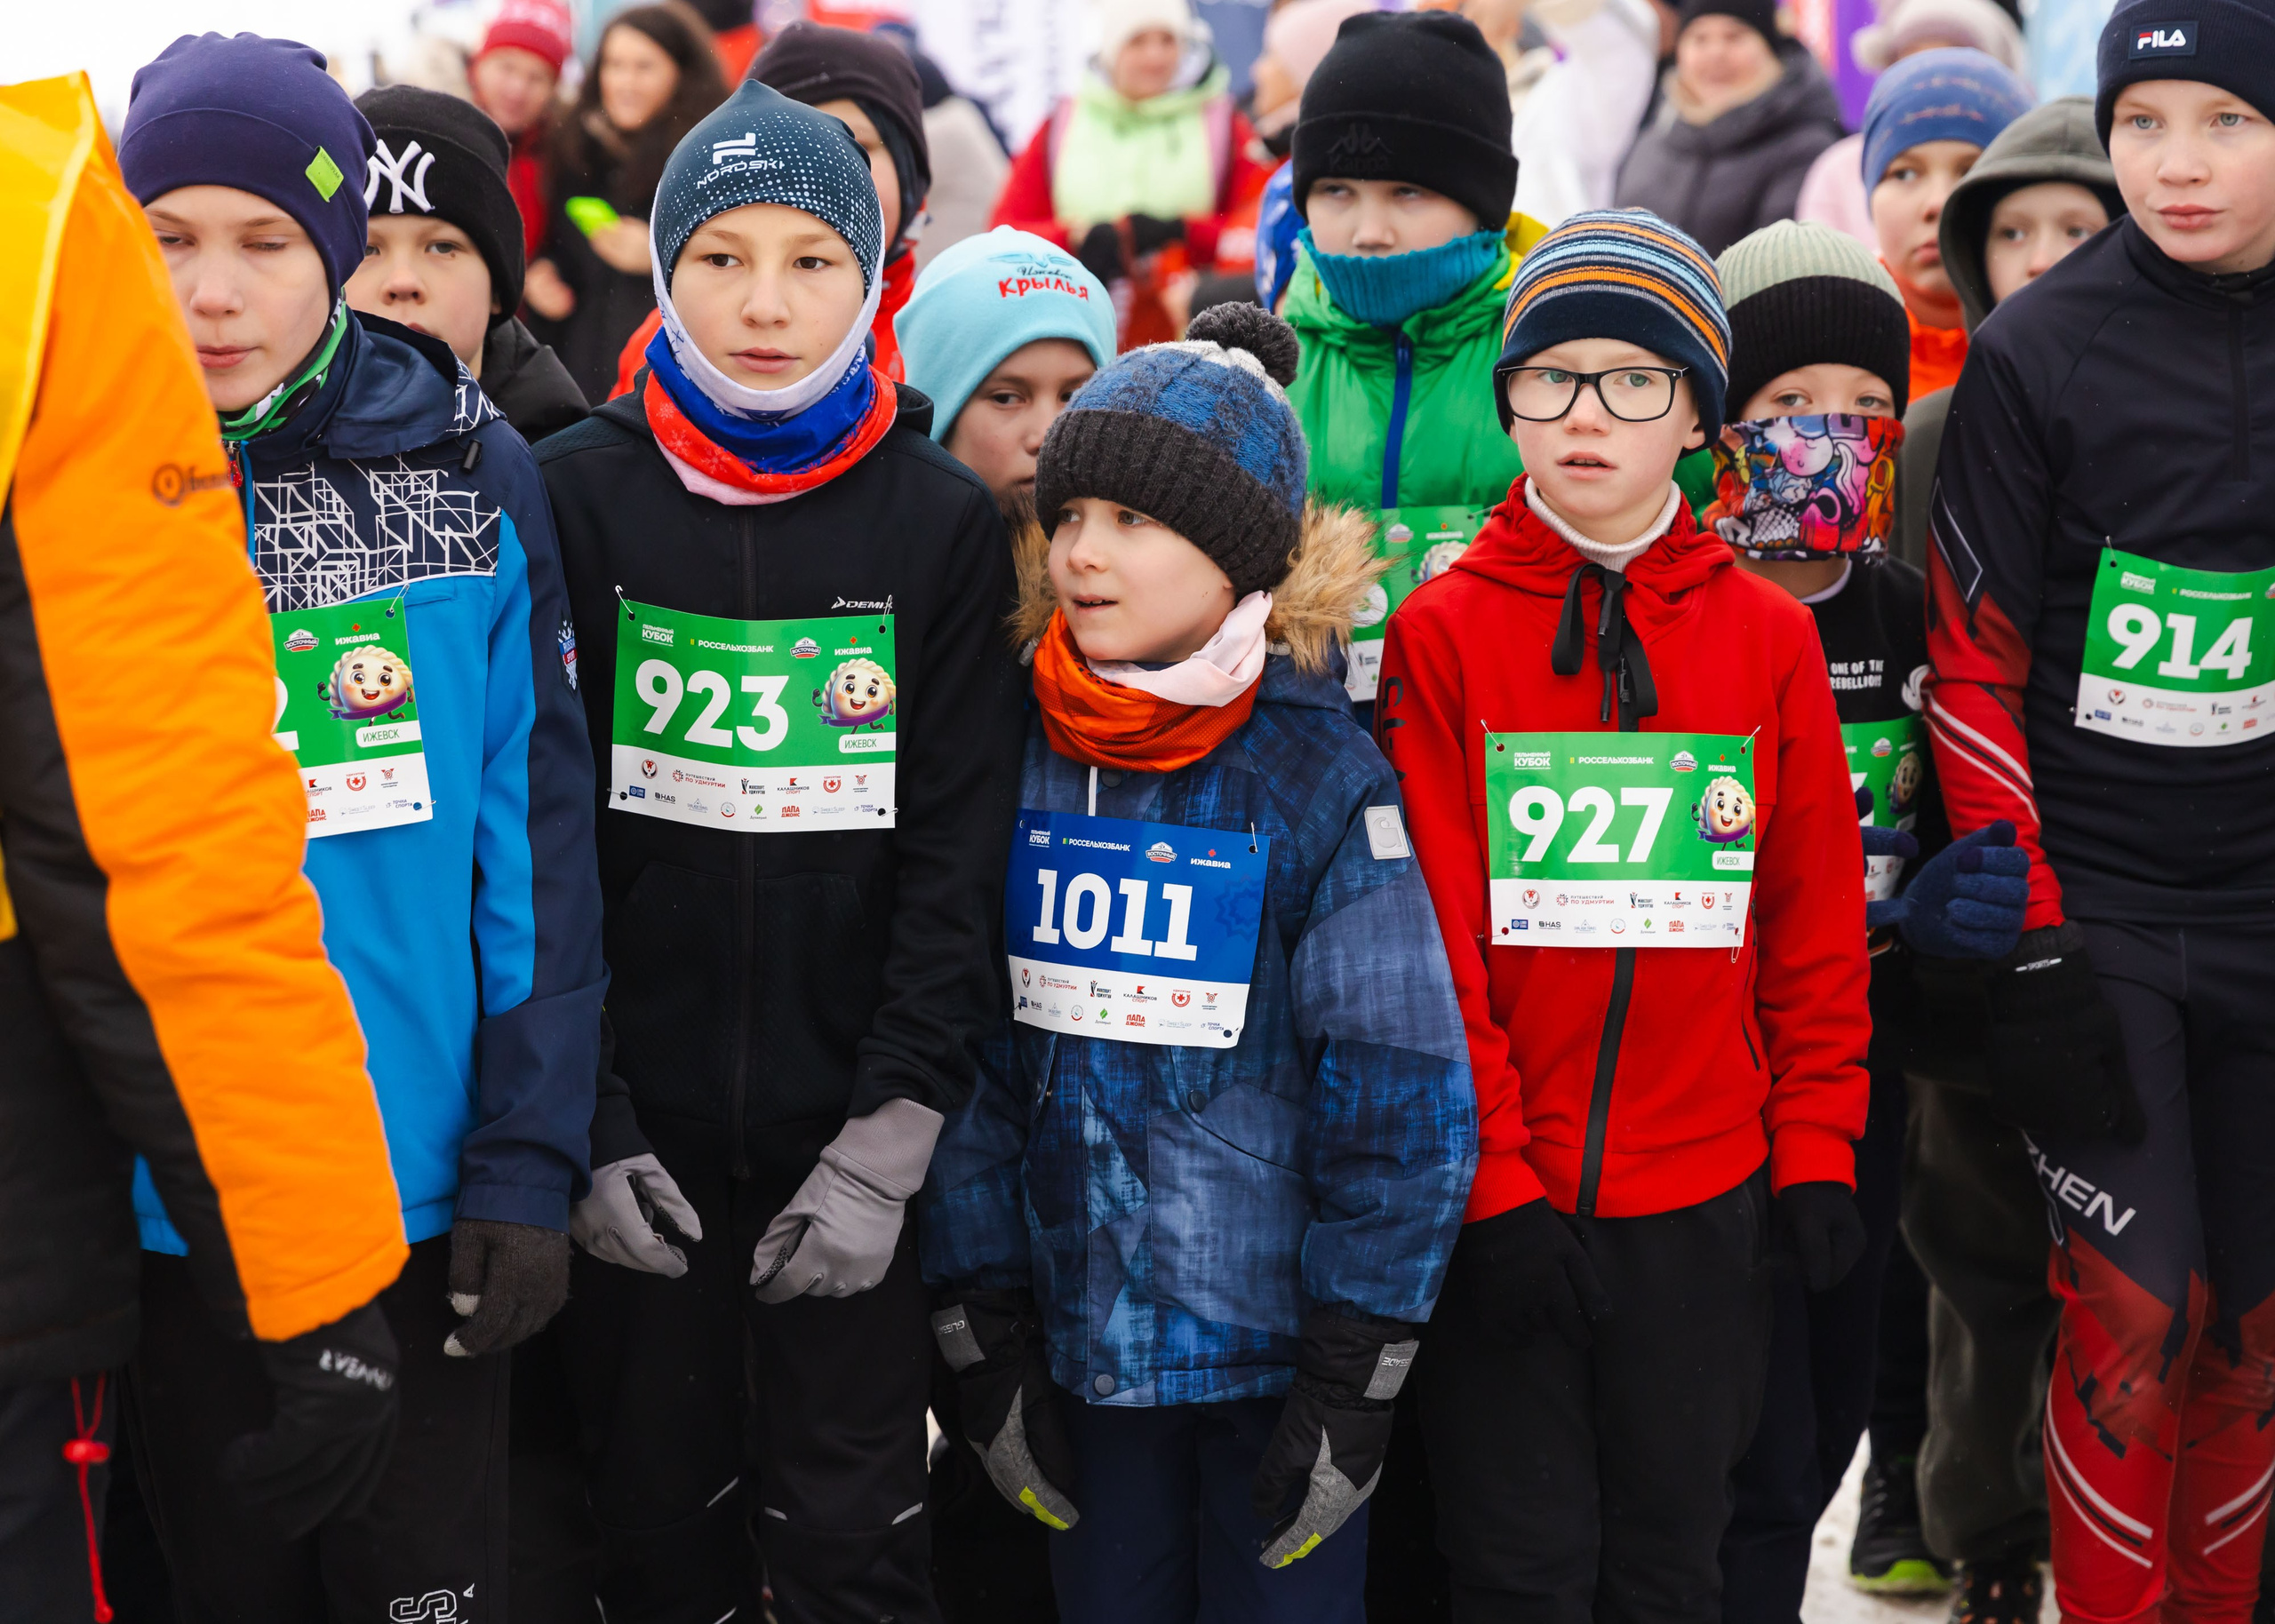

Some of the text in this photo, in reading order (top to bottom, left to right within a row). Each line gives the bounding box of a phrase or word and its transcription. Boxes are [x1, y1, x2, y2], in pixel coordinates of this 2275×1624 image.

[2137, 28, 2186, 50] FILA
[363, 139, 435, 213] NY
[698, 160, 785, 189] NORDSKI
[998, 277, 1089, 302] КРЫЛЬЯ
[2121, 576, 2155, 591] КУБОК
[285, 638, 318, 649] ВОСТОЧНЫЙ
[335, 633, 380, 645] ижавиа
[642, 629, 674, 644] КУБОК
[2107, 602, 2253, 681] 914
[698, 640, 774, 653] РОССЕЛЬХОЗБАНК
[834, 647, 873, 656] ижавиа
[1831, 662, 1848, 675] ONE
[1851, 661, 1865, 674] OF
[635, 659, 789, 752] 923
[270, 675, 299, 752] 2
[363, 728, 400, 742] ИЖЕВСК
[844, 739, 877, 749] ИЖЕВСК
[1514, 757, 1551, 767] КУБОК
[695, 778, 726, 789] УДМУРТИИ
[660, 792, 676, 802] HAS
[1509, 785, 1673, 863] 927
[1029, 834, 1050, 845] КУБОК
[1068, 838, 1130, 852] РОССЕЛЬХОЗБАНК
[1191, 858, 1231, 869] ижавиа
[1717, 856, 1740, 865] ИЖЕВСК
[1033, 868, 1197, 961] 1011
[1126, 1014, 1145, 1023] ПАПА
[390, 1588, 458, 1624] S
